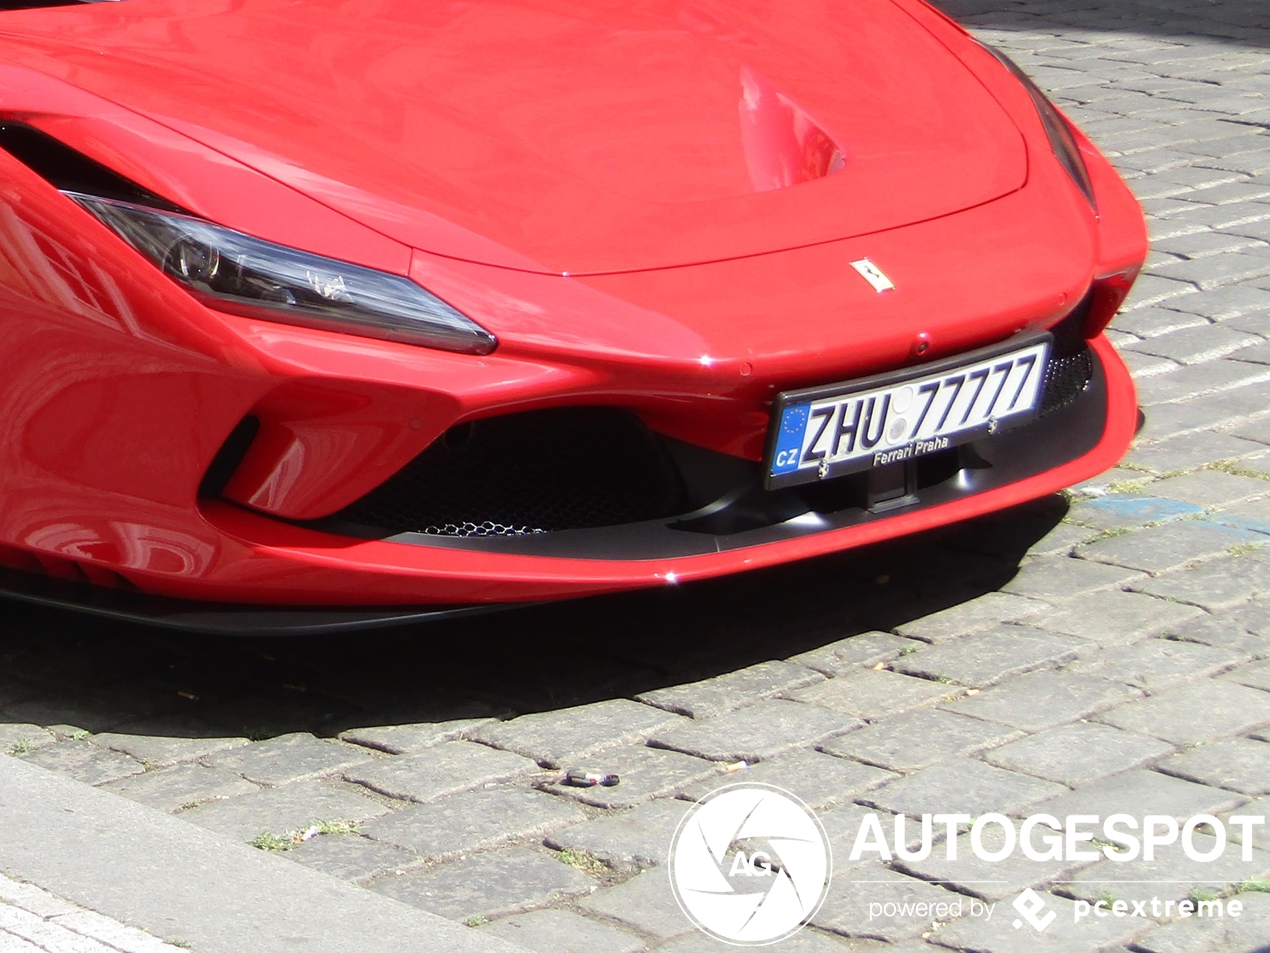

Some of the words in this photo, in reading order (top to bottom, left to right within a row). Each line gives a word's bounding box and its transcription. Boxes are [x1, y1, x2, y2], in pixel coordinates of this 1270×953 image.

[802, 394, 892, 463] ZHU
[910, 354, 1037, 440] 77777
[776, 449, 798, 467] CZ
[873, 444, 912, 466] Ferrari
[914, 435, 949, 453] Praha
